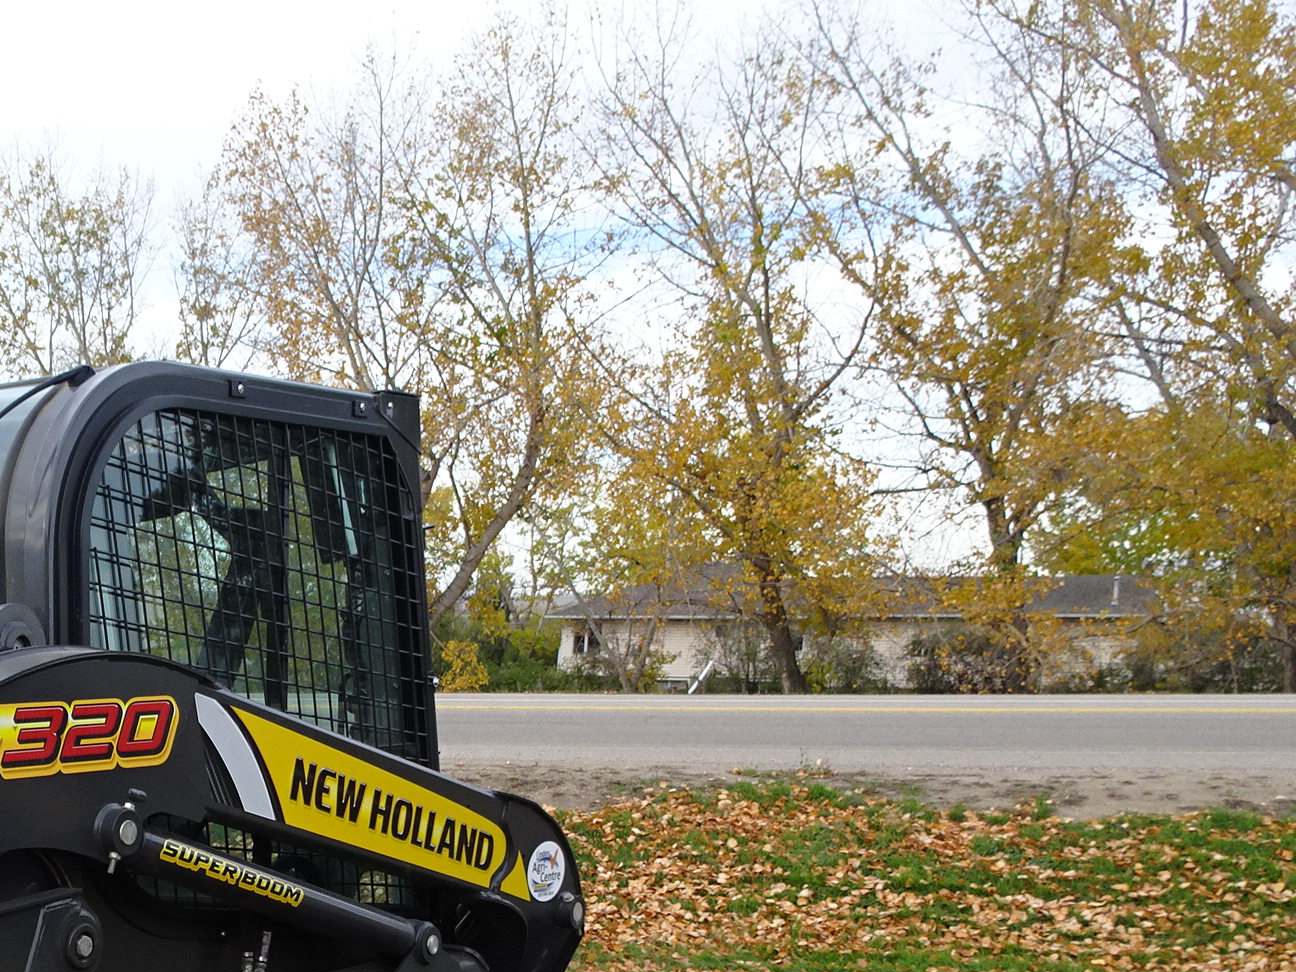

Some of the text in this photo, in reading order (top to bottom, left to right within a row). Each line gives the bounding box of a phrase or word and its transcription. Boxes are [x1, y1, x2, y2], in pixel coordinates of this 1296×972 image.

[289, 756, 494, 871] NEW HOLLAND
[540, 871, 561, 882] Centre
